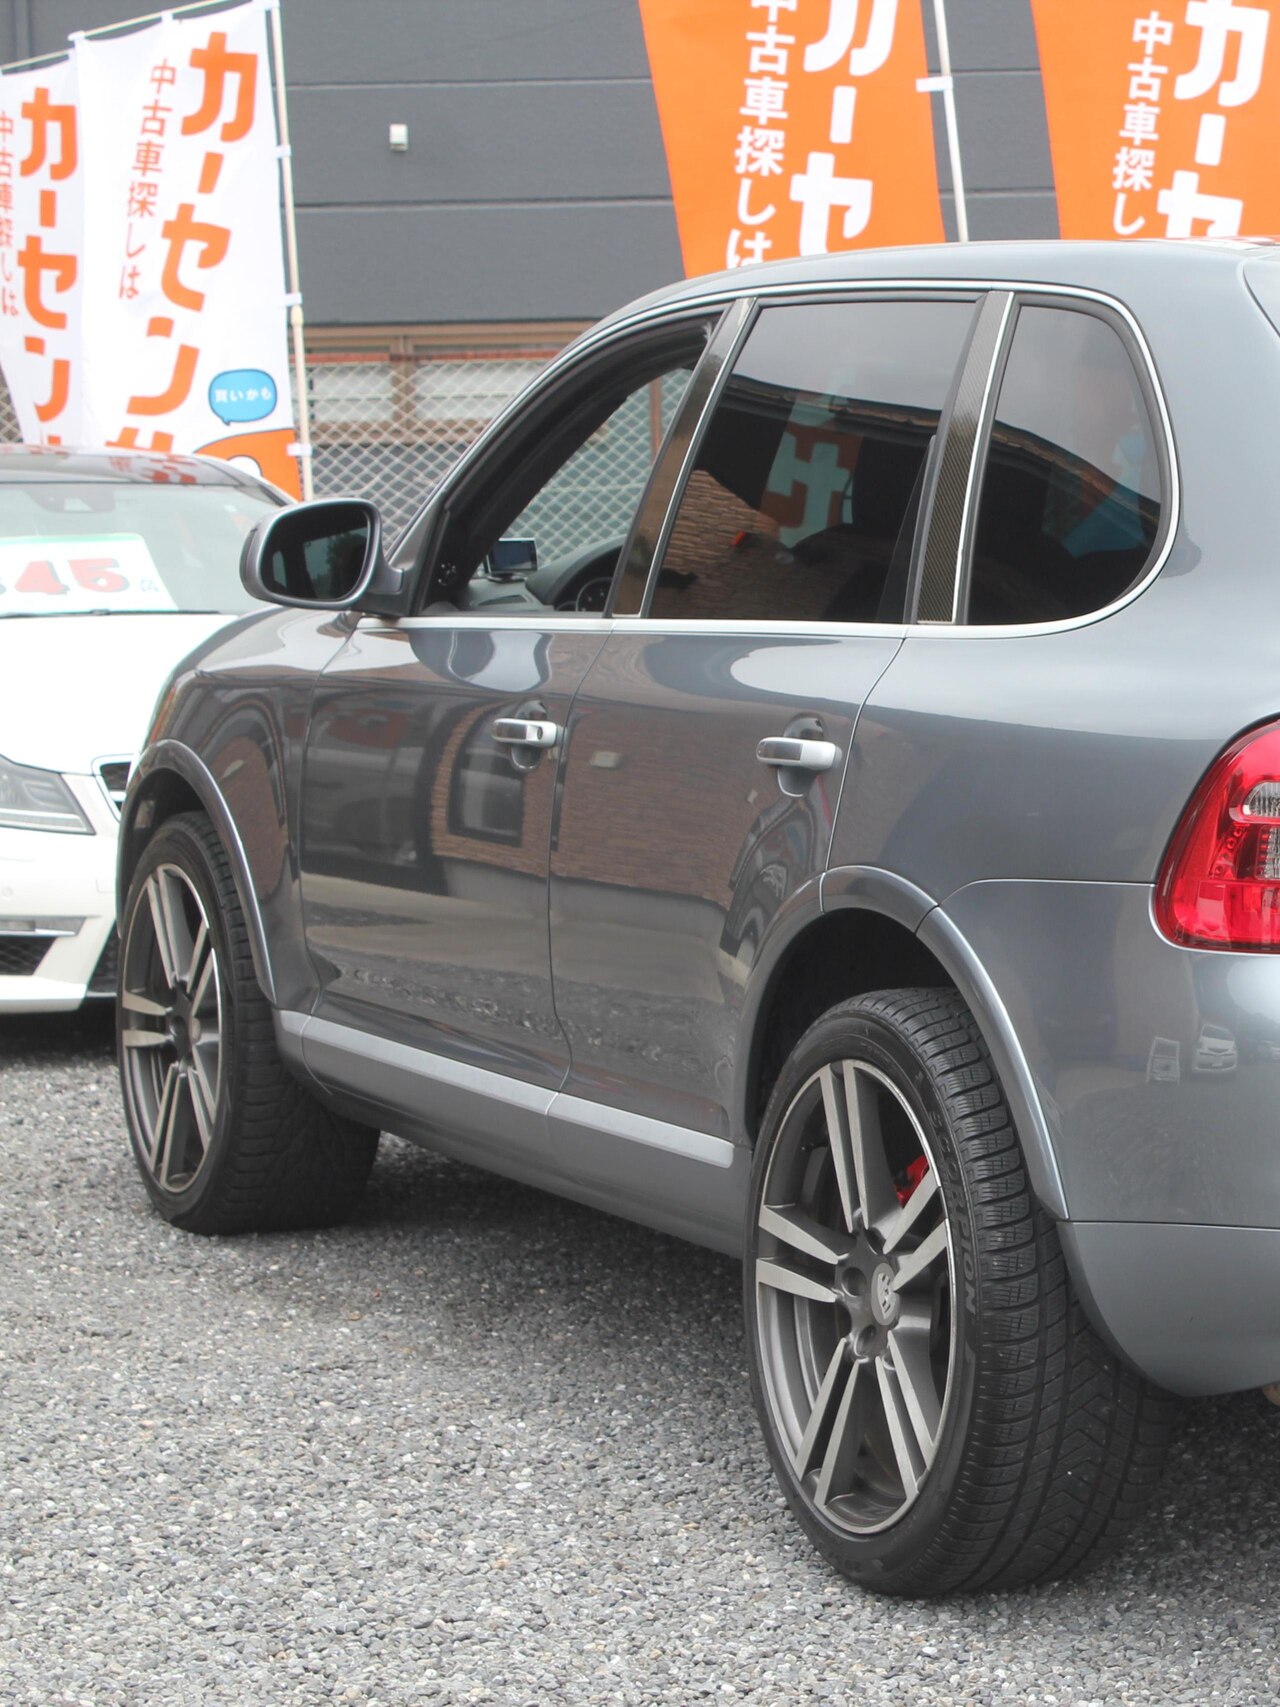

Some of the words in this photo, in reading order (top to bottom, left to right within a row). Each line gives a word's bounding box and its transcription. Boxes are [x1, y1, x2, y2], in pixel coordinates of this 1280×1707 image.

[119, 58, 177, 300] 中古車探しは
[1112, 11, 1174, 236] 中古車探し
[17, 86, 78, 446] カーセン
